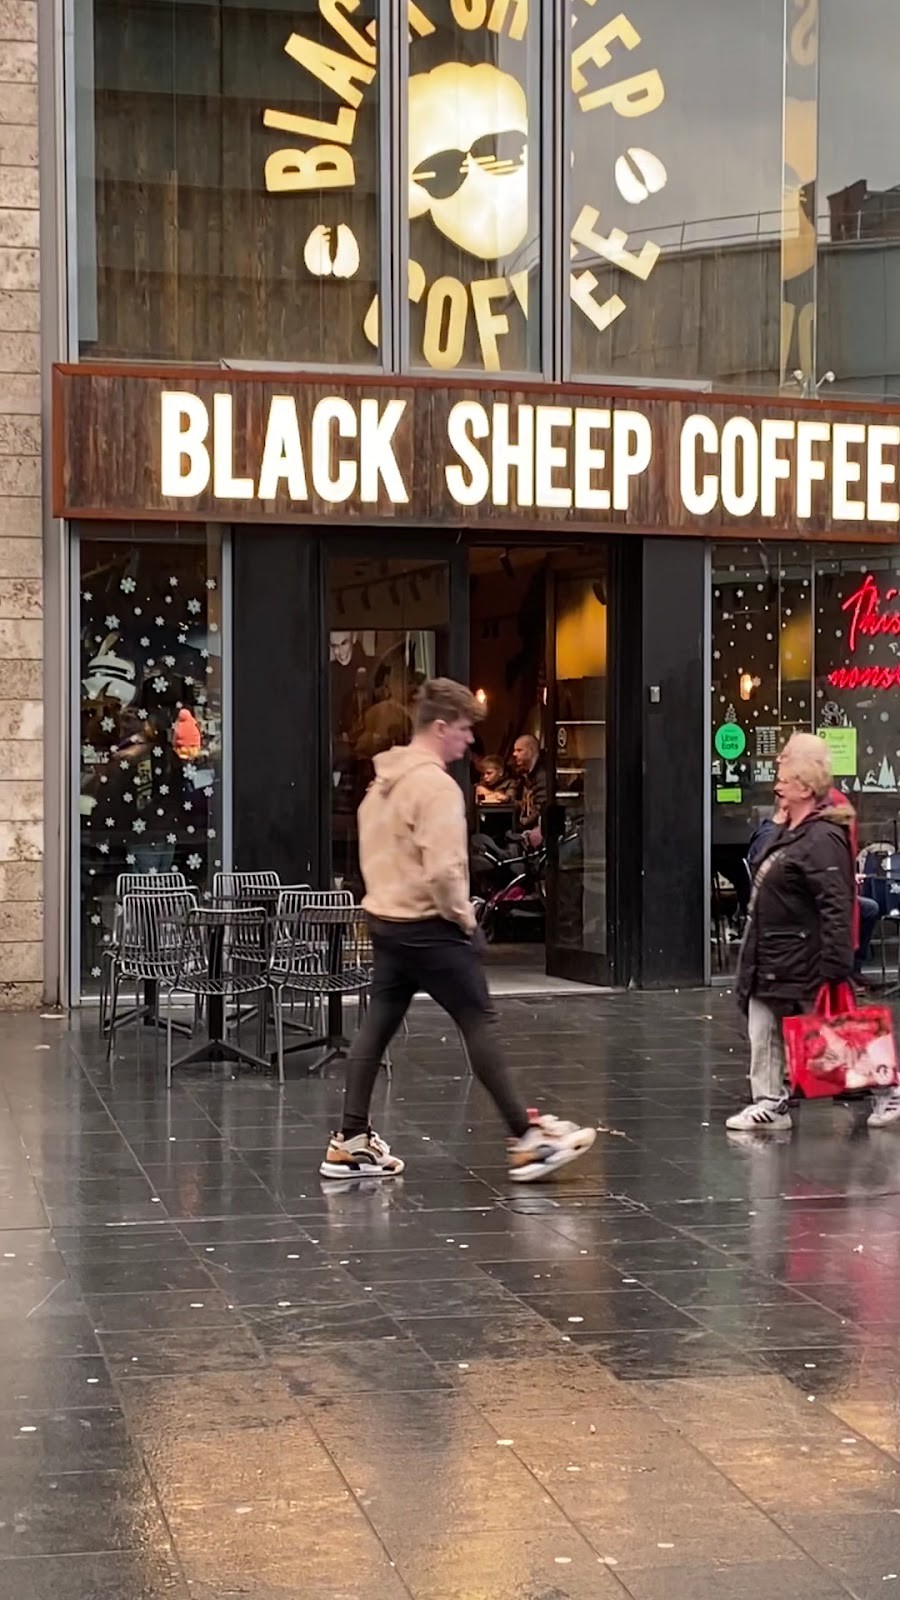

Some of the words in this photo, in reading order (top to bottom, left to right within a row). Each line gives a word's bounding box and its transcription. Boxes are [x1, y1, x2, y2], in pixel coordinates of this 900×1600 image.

[161, 390, 409, 503] BLACK
[445, 400, 652, 511] SHEEP
[680, 414, 900, 521] COFFEE
[721, 742, 739, 750] Eats
